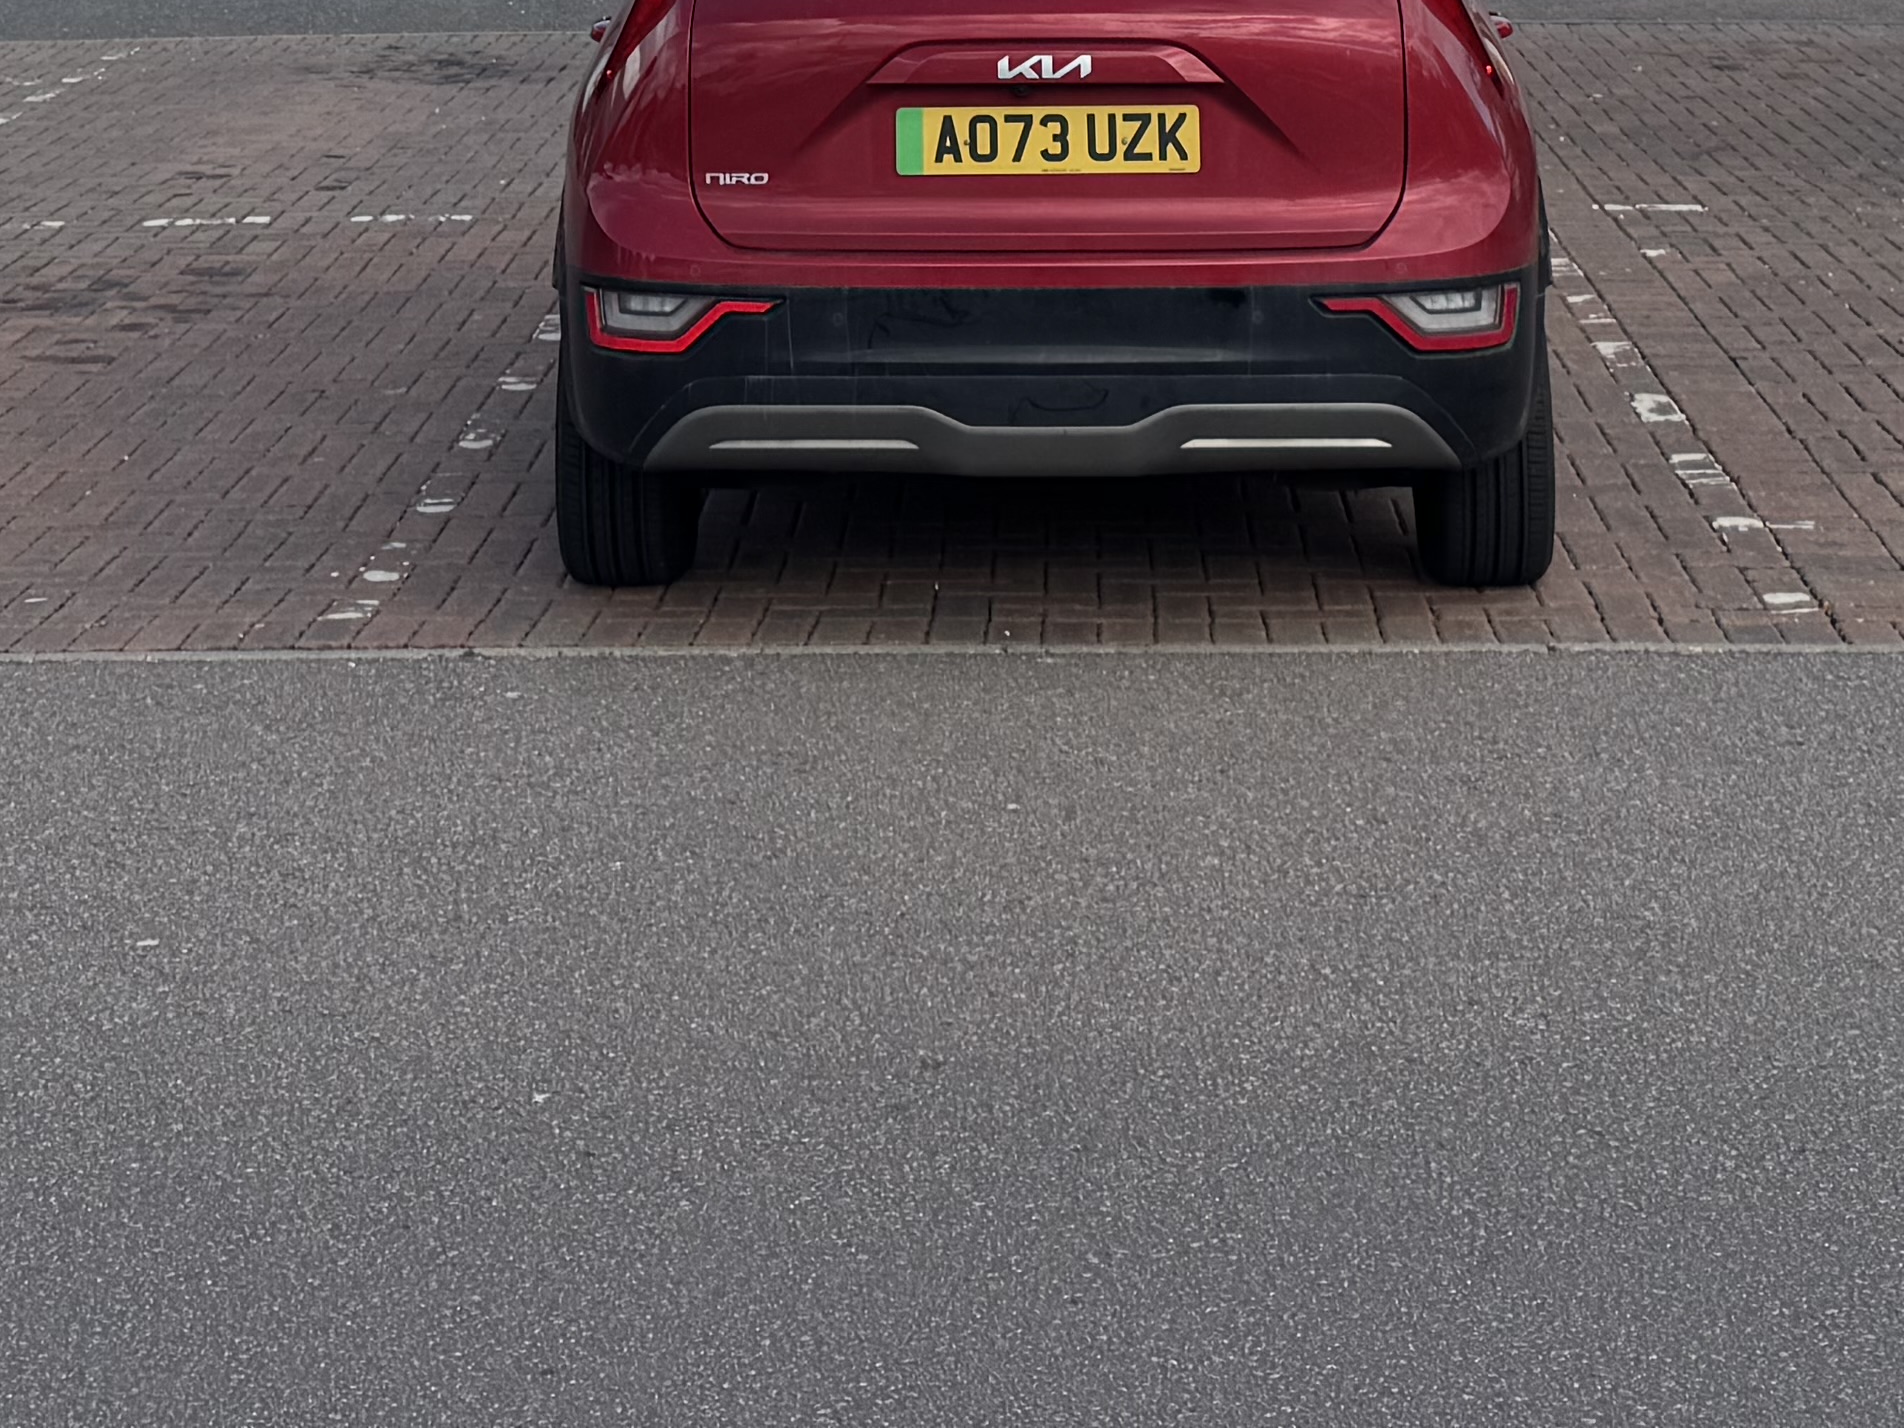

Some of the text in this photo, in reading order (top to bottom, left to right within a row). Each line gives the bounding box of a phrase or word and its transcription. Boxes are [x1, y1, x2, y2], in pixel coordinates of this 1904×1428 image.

[997, 55, 1091, 79] KIA
[1086, 112, 1189, 161] UZK
[705, 173, 769, 185] NIRO
